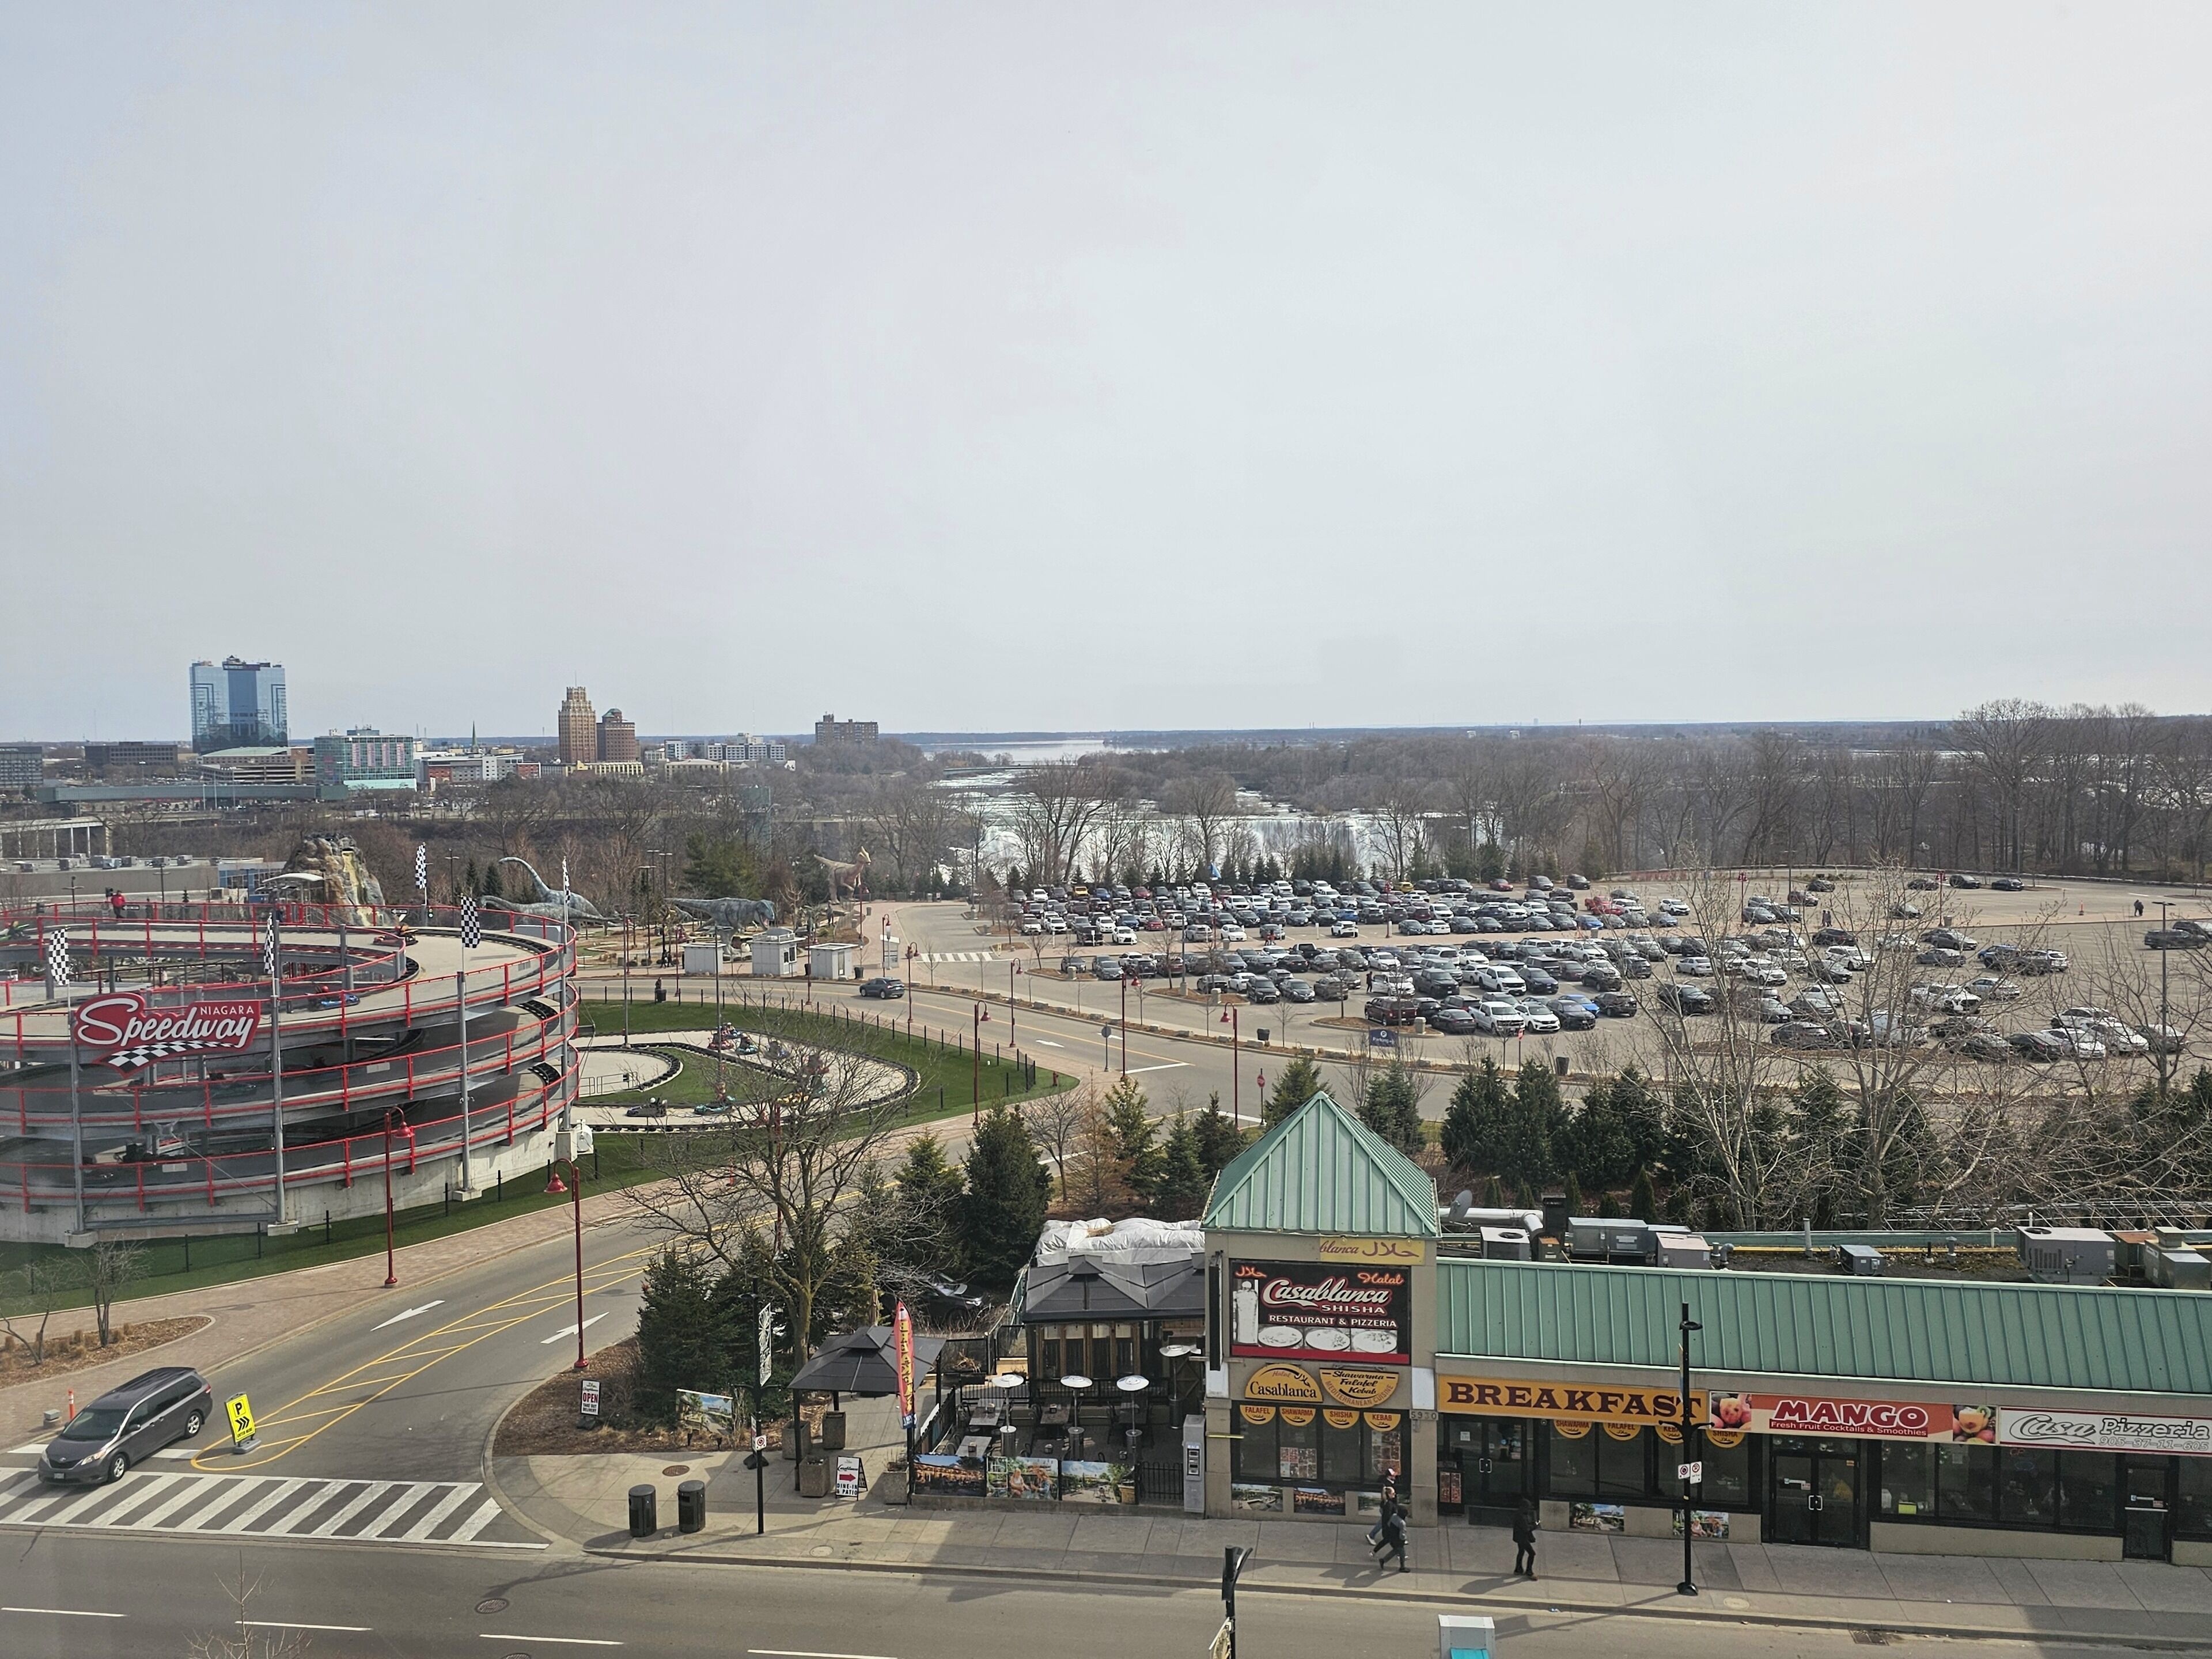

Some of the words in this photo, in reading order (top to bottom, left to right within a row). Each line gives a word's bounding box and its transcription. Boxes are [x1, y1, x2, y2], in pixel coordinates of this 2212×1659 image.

[200, 1006, 254, 1016] NIAGARA
[77, 998, 254, 1048] Speedway
[1362, 1242, 1419, 1257] حلال
[1234, 1266, 1267, 1278] حلال
[1357, 1272, 1404, 1285] Halal
[1263, 1278, 1389, 1308] Casablanca
[1321, 1304, 1385, 1314] SHISHA
[1269, 1315, 1335, 1325] RESTAURANT
[1351, 1319, 1397, 1327] PIZZERIA
[1332, 1370, 1384, 1380] Shawarma
[1340, 1378, 1378, 1387] Falafel
[1249, 1381, 1317, 1398] Casablanca
[1325, 1380, 1373, 1407] MEDITERRANEAN
[1373, 1384, 1393, 1404] CUISINE
[583, 1392, 599, 1403] OPEN
[1447, 1382, 1702, 1418] BREAKFAST
[235, 1402, 242, 1415] P
[1245, 1407, 1270, 1415] FALAFEL
[1282, 1408, 1313, 1416] SHAWARMA
[1772, 1400, 1929, 1429] MANGO
[1330, 1411, 1353, 1419] SHISHA
[1556, 1420, 1589, 1429] SHAWARMA
[1608, 1422, 1635, 1430] FALAFEL
[1771, 1421, 1796, 1429] Fresh
[1823, 1424, 1865, 1433] Cocktails
[1877, 1427, 1927, 1436] Smoothies
[2009, 1414, 2096, 1444] Casa
[2100, 1418, 2210, 1440] Pizzeria
[2099, 1436, 2209, 1451] 905-37-11-605
